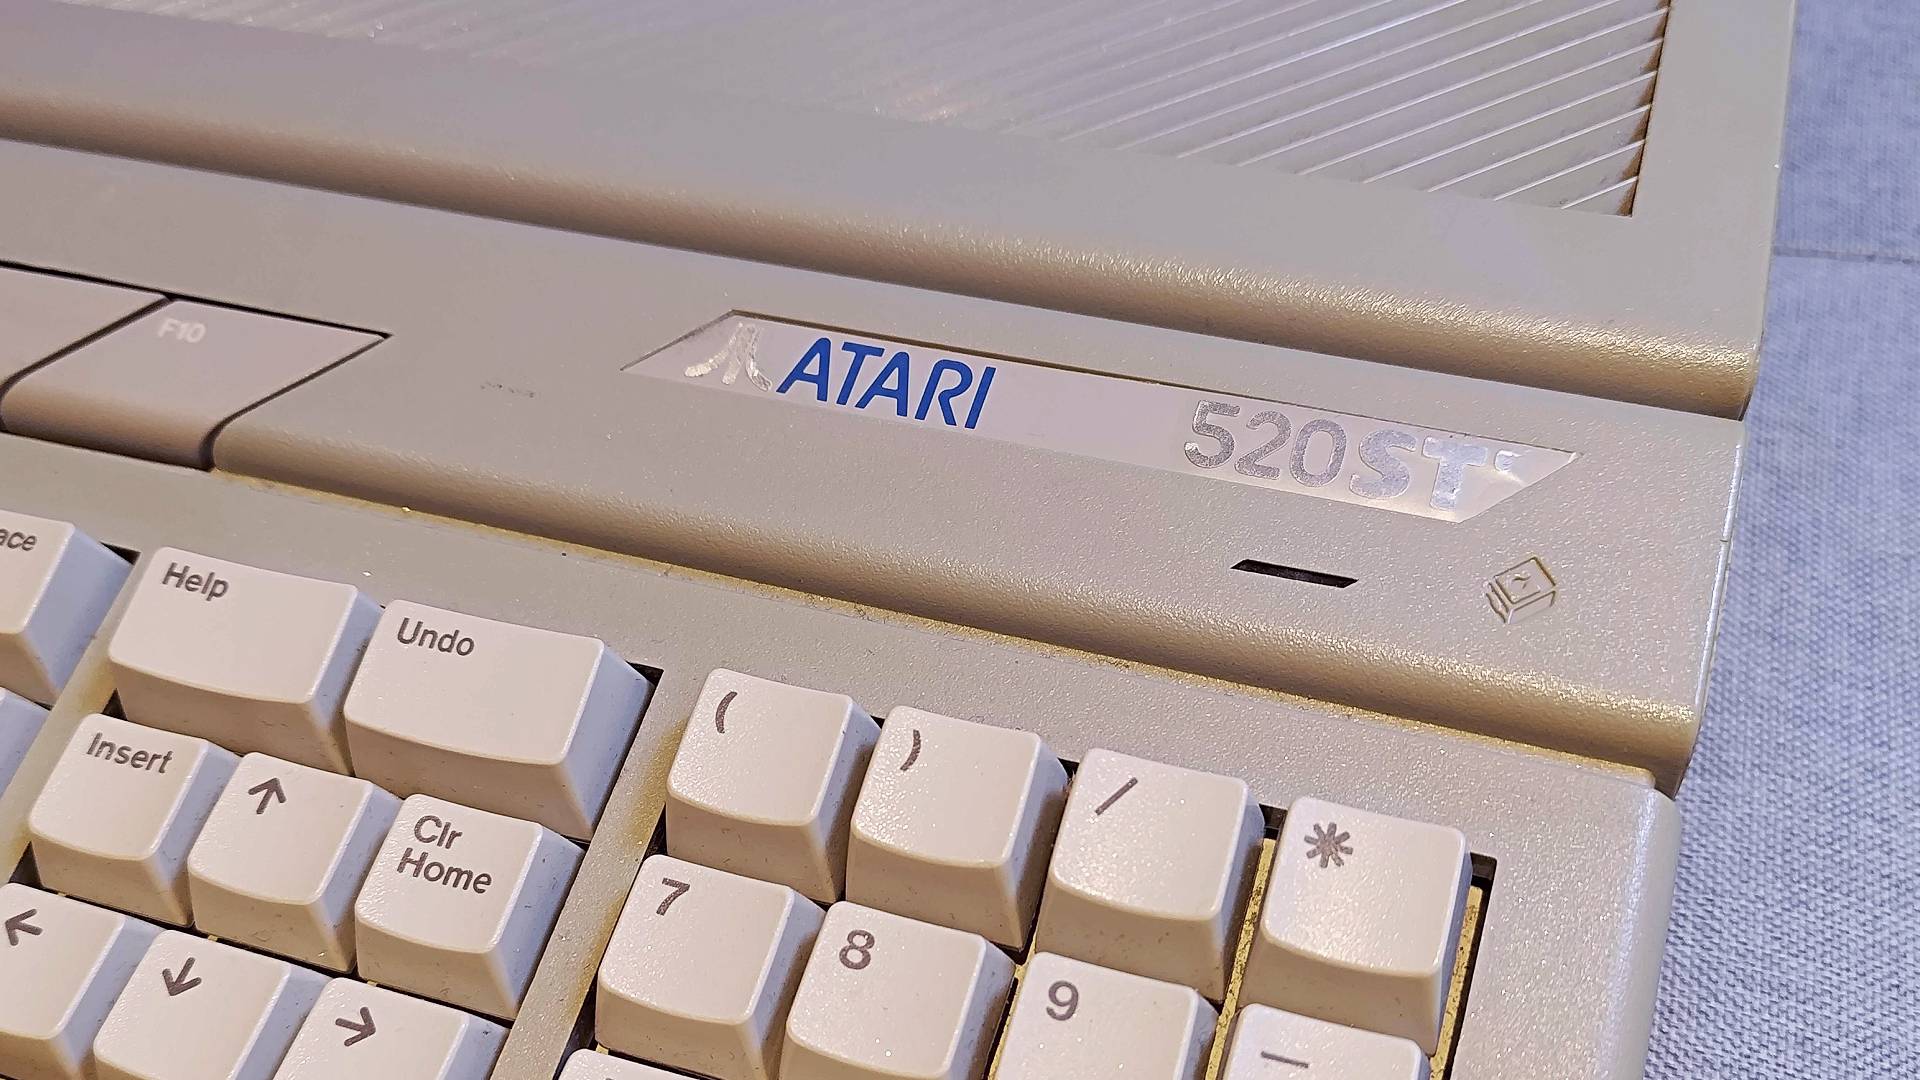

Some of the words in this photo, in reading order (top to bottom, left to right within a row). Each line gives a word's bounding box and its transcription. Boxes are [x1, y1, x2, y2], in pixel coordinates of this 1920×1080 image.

[158, 318, 206, 343] F10
[776, 337, 996, 429] ATARI
[162, 563, 228, 601] Help
[397, 618, 475, 656] Undo
[87, 732, 174, 773] Insert
[413, 815, 462, 849] Clr
[397, 847, 492, 893] Home
[656, 878, 690, 915] 7
[839, 930, 875, 969] 8
[1047, 981, 1079, 1021] 9
